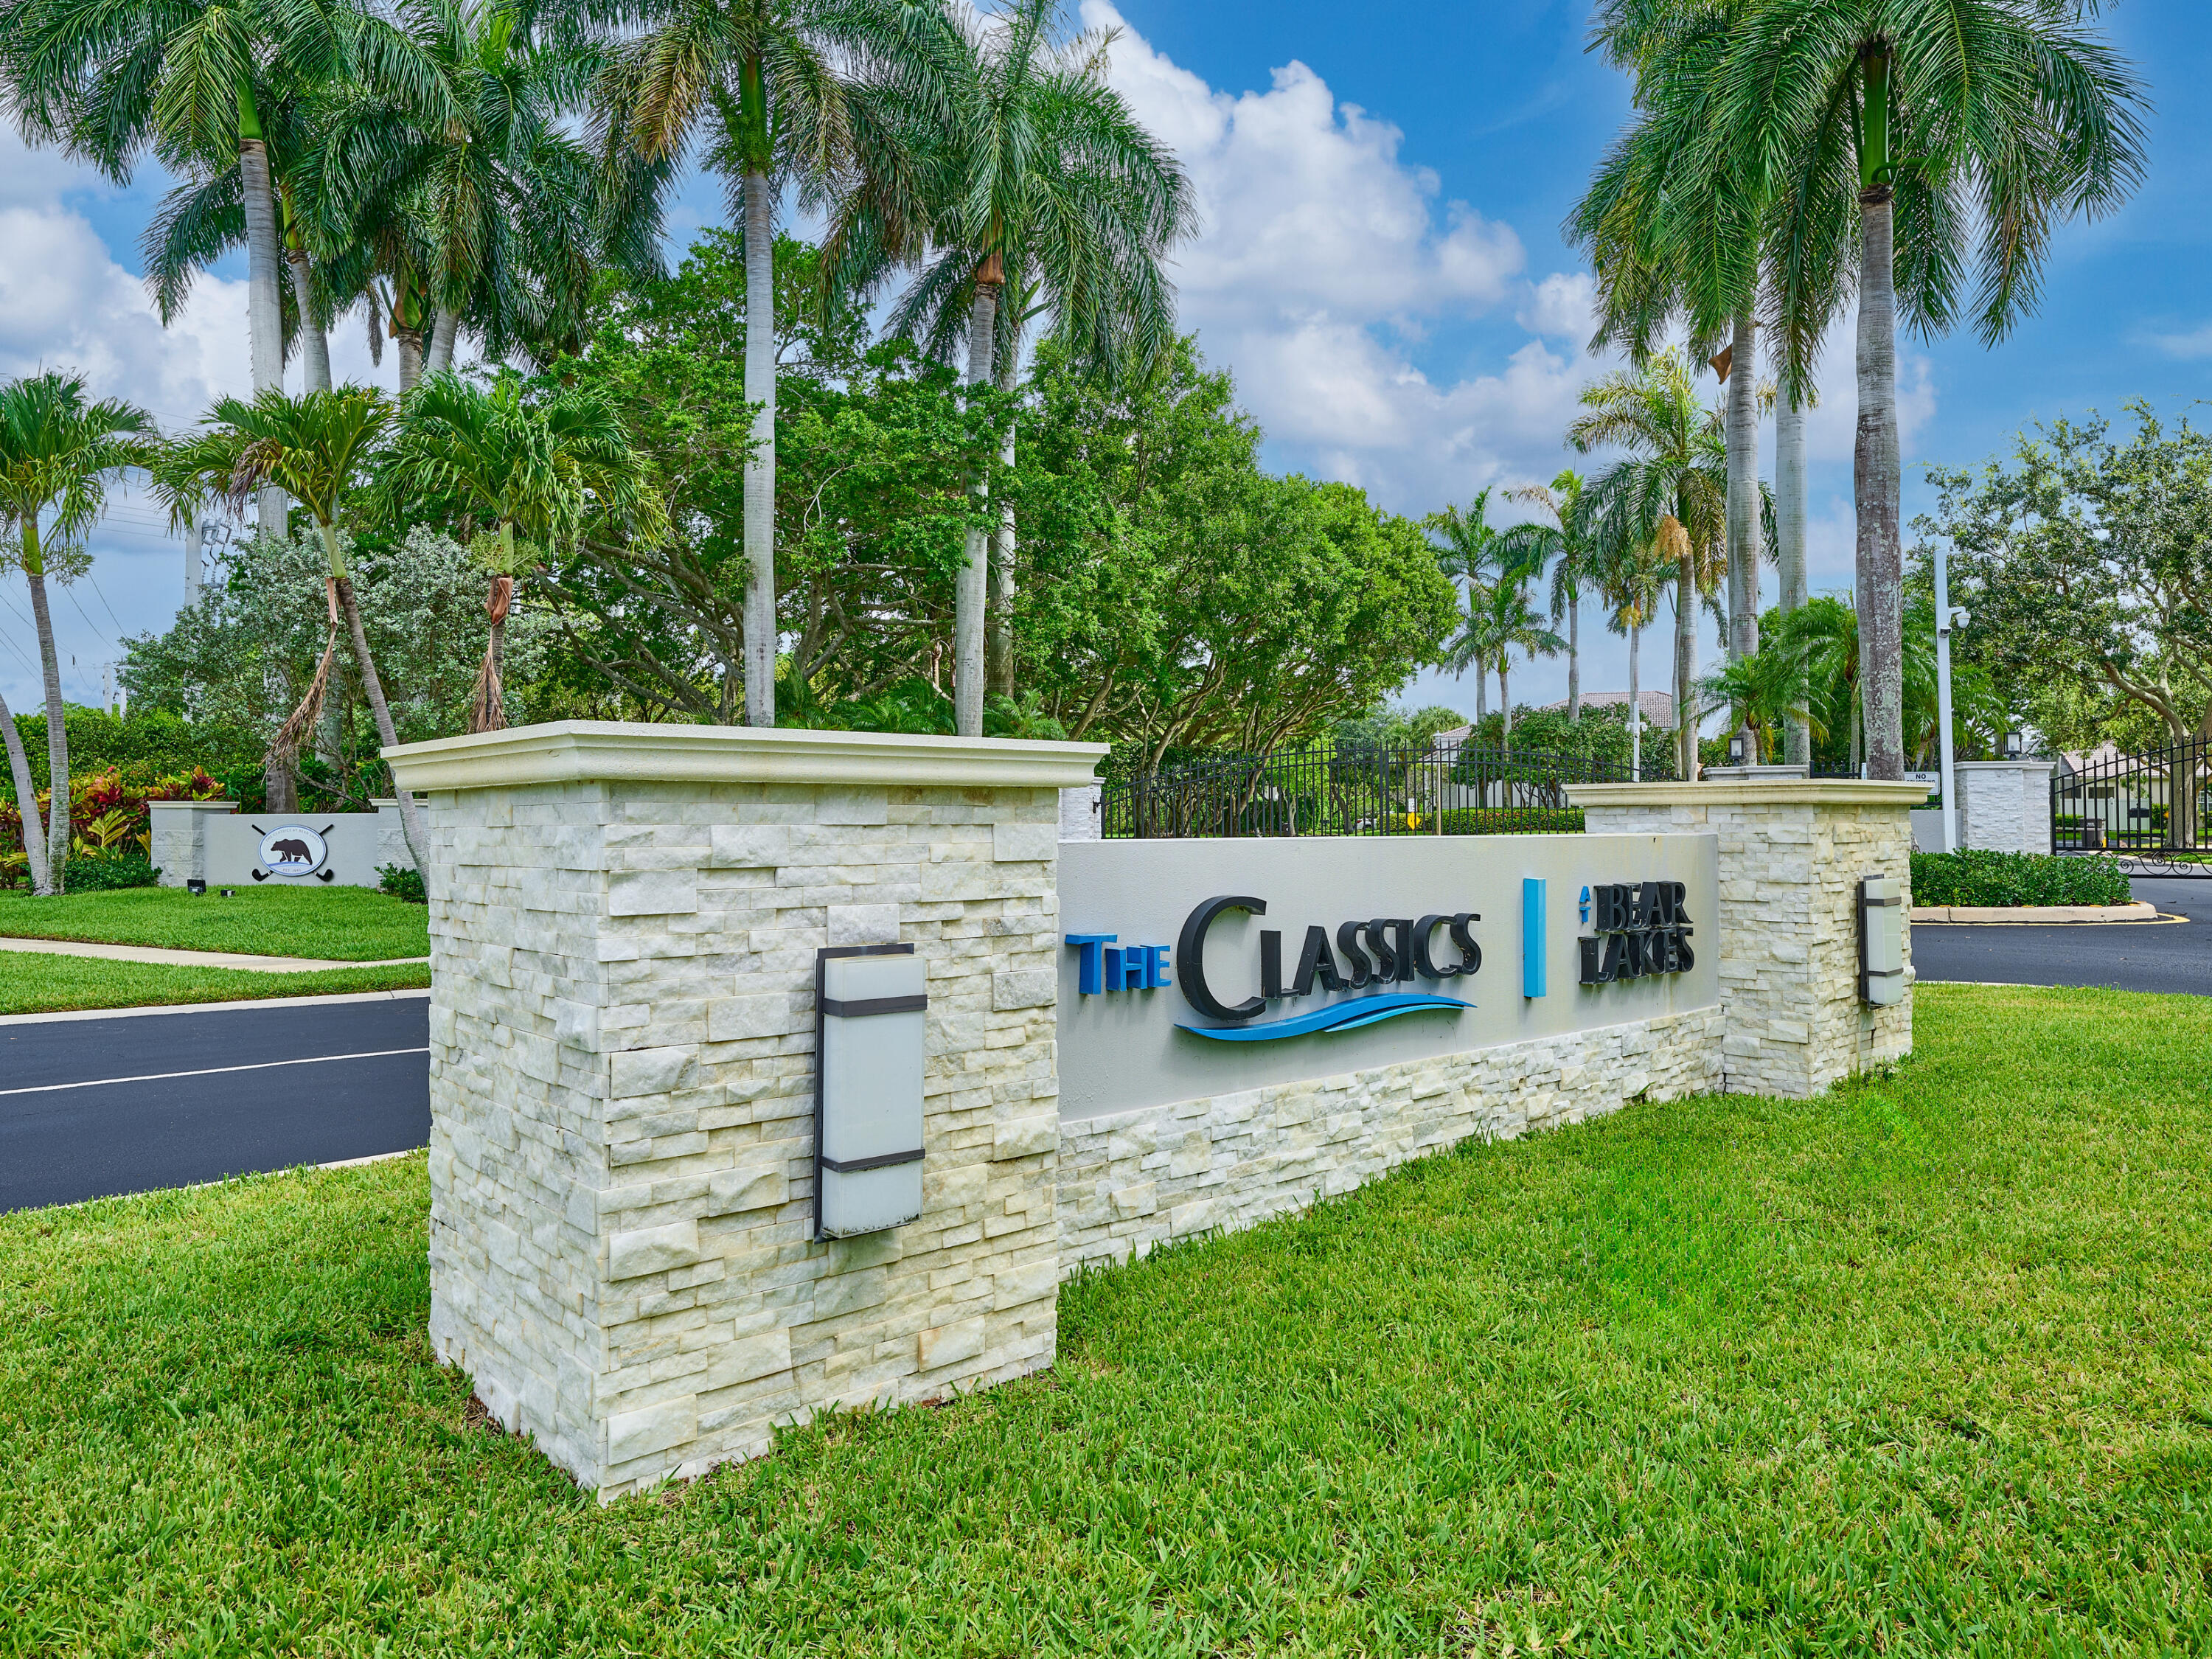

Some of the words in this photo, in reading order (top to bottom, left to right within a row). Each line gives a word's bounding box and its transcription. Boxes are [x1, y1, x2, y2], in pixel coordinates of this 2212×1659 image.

[1593, 880, 1694, 932] BEAR
[1065, 932, 1172, 995] THE
[1177, 895, 1482, 1020] CLASSICS
[1578, 927, 1695, 984] LAKES
